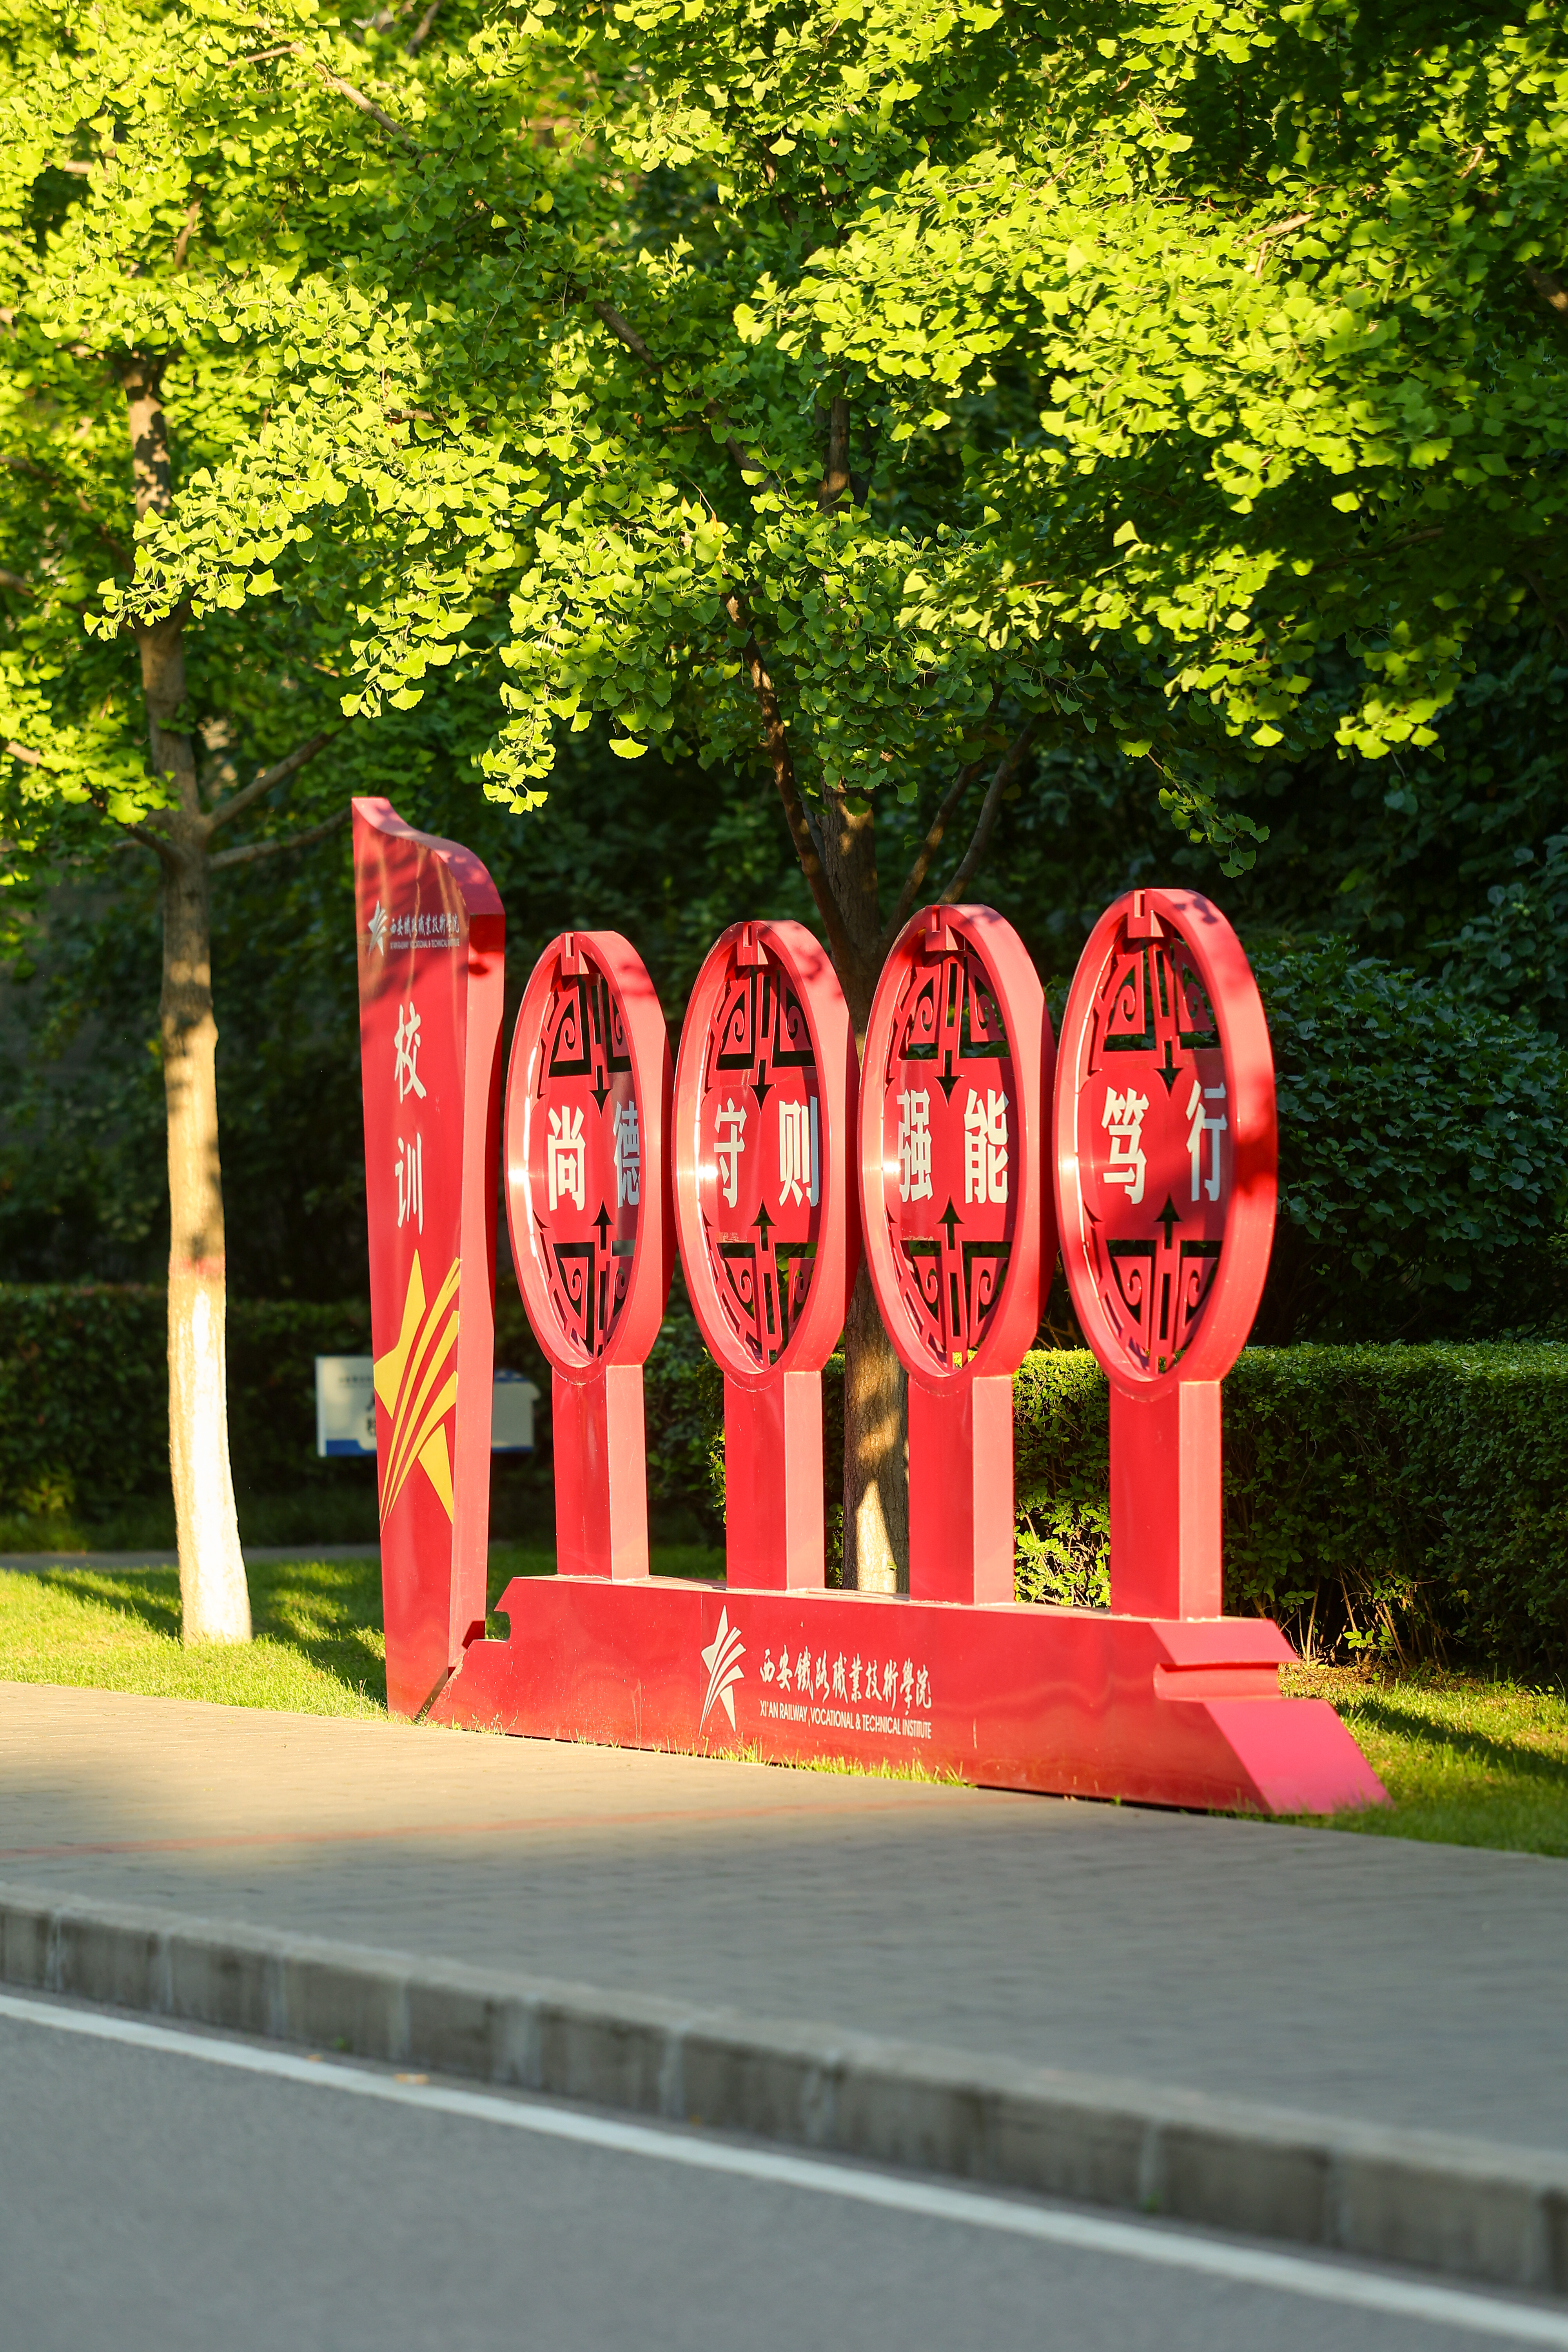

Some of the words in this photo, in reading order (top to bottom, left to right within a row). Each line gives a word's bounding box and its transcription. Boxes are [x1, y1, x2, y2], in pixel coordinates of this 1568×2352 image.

[394, 1001, 426, 1235] 校训
[548, 1100, 640, 1211] 尚德
[713, 1096, 820, 1208] 守则
[897, 1087, 1009, 1205] 强能
[1101, 1079, 1227, 1205] 笃行
[760, 1700, 778, 1718] XI'AN
[810, 1707, 854, 1730] VOCATIONAL
[855, 1713, 861, 1730] &
[862, 1714, 901, 1735] TECHNICAL
[902, 1718, 932, 1739] INSTITUTE
